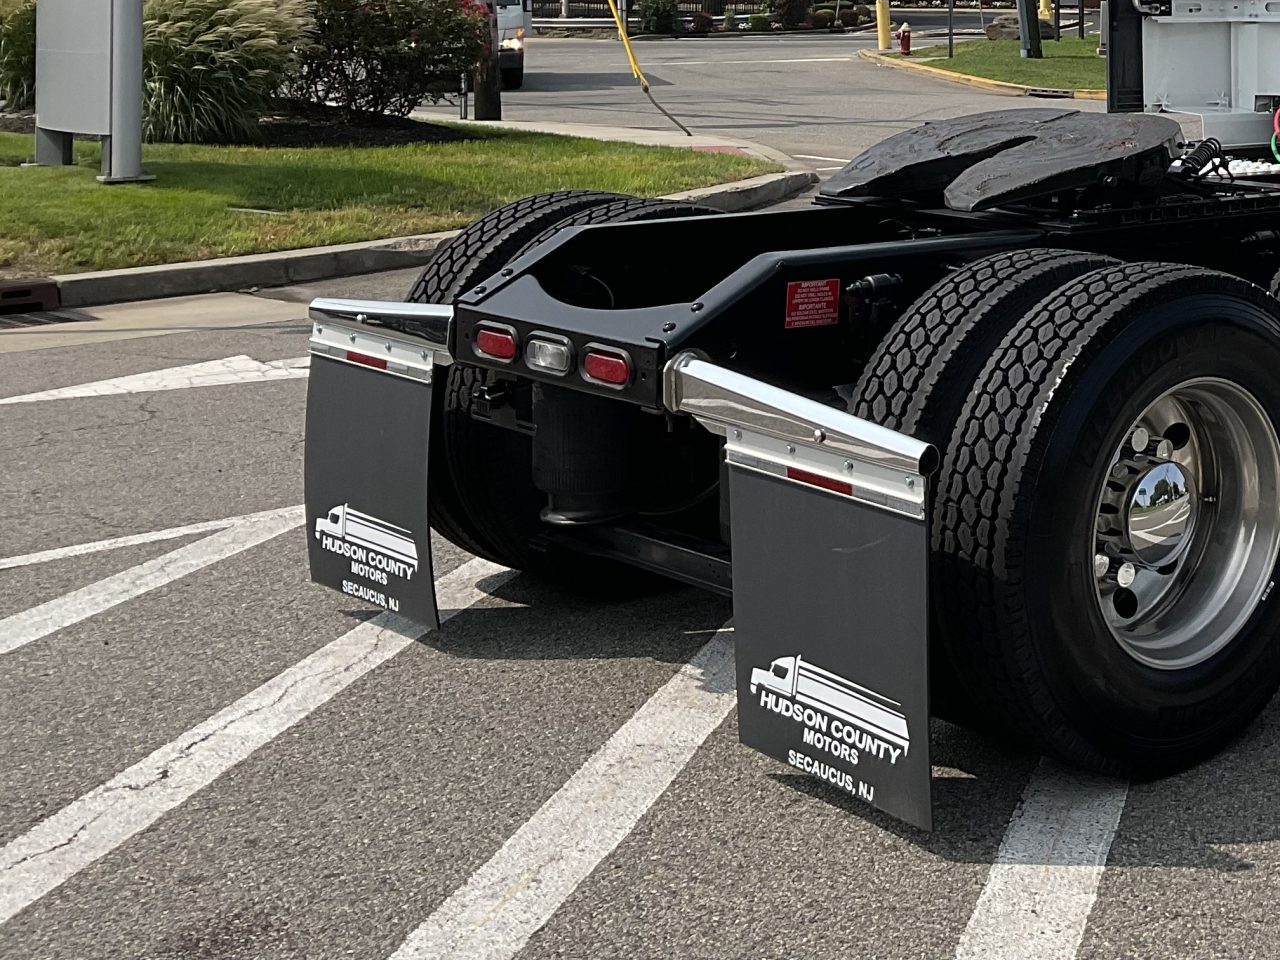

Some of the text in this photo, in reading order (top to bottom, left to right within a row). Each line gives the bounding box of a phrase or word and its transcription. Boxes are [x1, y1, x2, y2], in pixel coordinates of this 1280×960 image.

[322, 535, 413, 580] HUDSON COUNTY
[351, 561, 388, 585] MOTORS
[342, 580, 399, 612] SECAUCUS, NJ
[760, 690, 901, 765] HUDSON COUNTY
[803, 727, 859, 765] MOTORS
[788, 749, 874, 802] SECAUCUS, NJ
